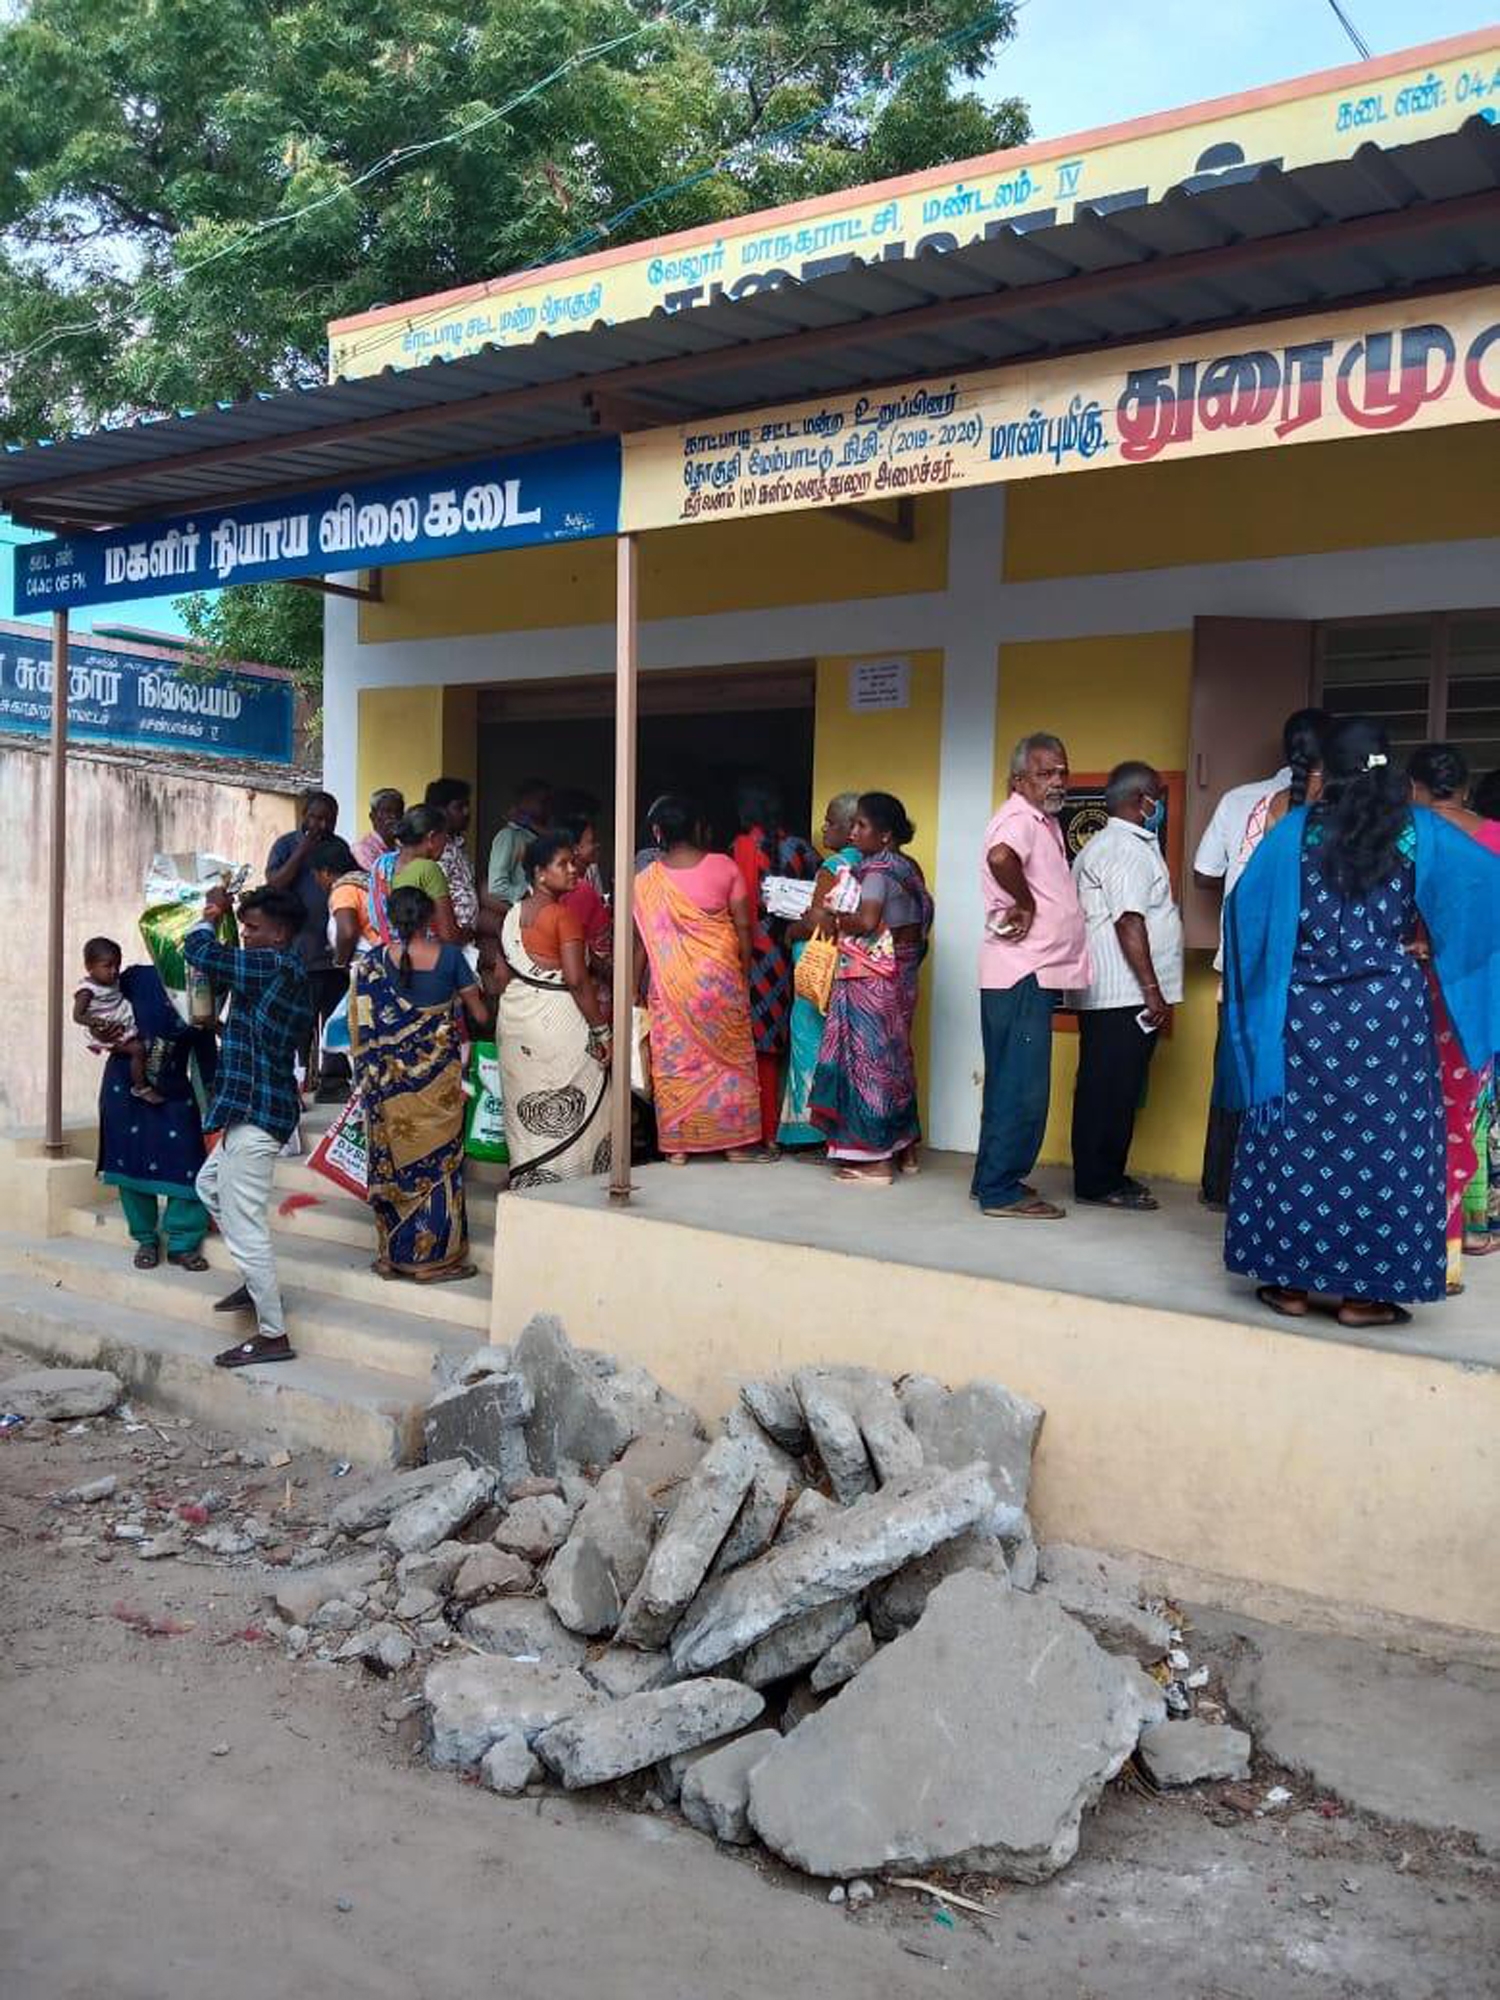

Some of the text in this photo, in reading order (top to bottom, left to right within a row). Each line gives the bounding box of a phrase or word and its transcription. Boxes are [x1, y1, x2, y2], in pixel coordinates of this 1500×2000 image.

[1337, 94, 1387, 131] கடை
[648, 239, 725, 285] வேலூர்
[1055, 160, 1083, 201] IV
[803, 409, 845, 438] மன்ற
[855, 383, 960, 431] உறுப்பினர்
[684, 453, 742, 491] தொகுதி
[105, 521, 200, 585] மகளிர்
[209, 518, 309, 579] நியாய
[138, 673, 241, 720] நிலையம்
